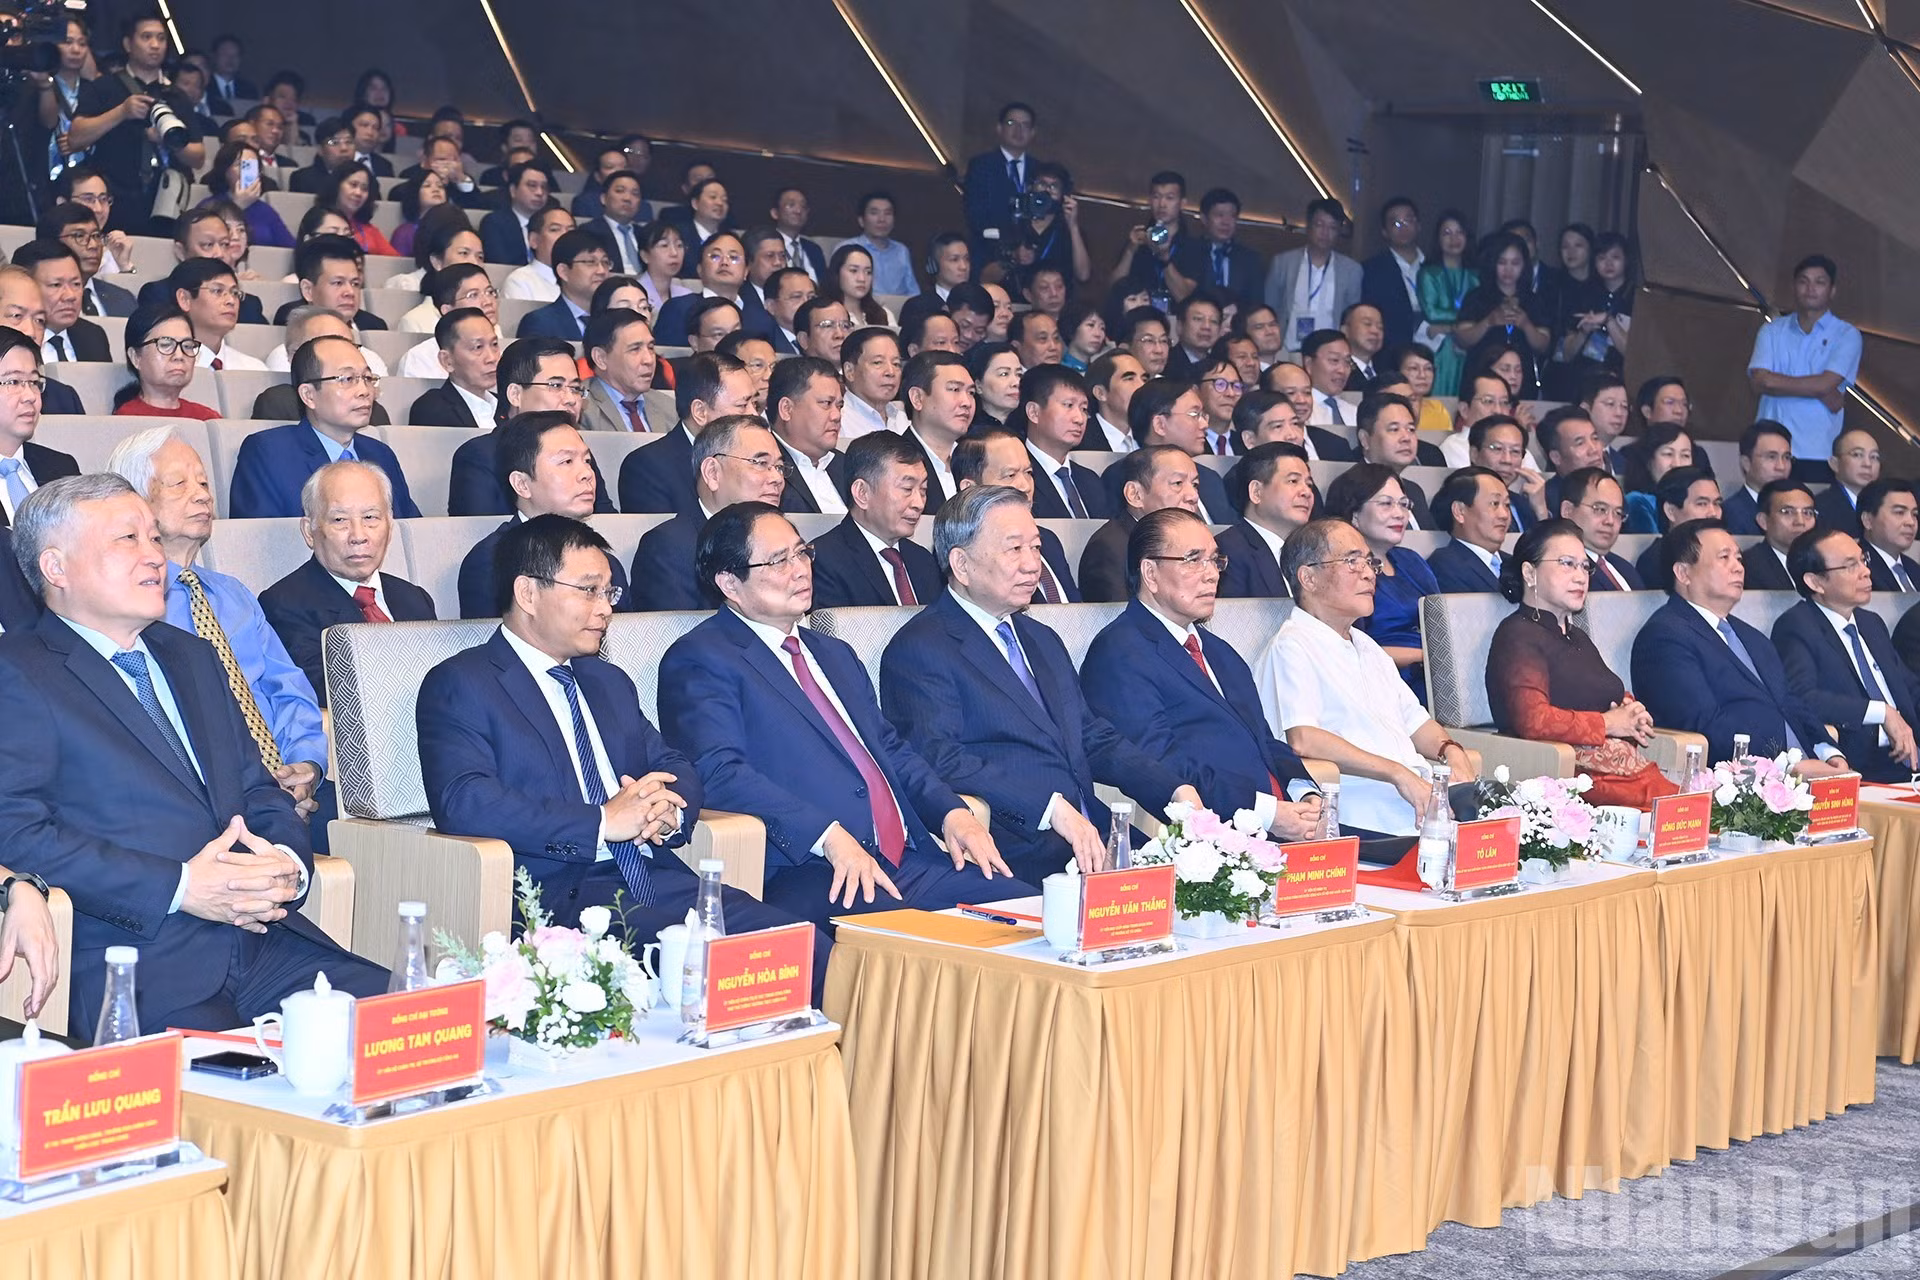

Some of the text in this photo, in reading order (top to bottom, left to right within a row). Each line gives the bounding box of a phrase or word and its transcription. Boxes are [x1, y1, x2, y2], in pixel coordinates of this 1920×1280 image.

[1491, 83, 1527, 92] EXIT
[1477, 846, 1497, 859] TÔ LÂM
[1286, 866, 1346, 884] PHẠM MINH CHÍNH
[1089, 896, 1167, 919] NGUYỄN VĂN THẮNG
[718, 964, 799, 991] NGUYỄN HÒA BÌNH
[364, 1024, 472, 1058] LƯƠNG TAM QUANG
[84, 1098, 111, 1117] LƯU
[114, 1088, 161, 1113] QUANG
